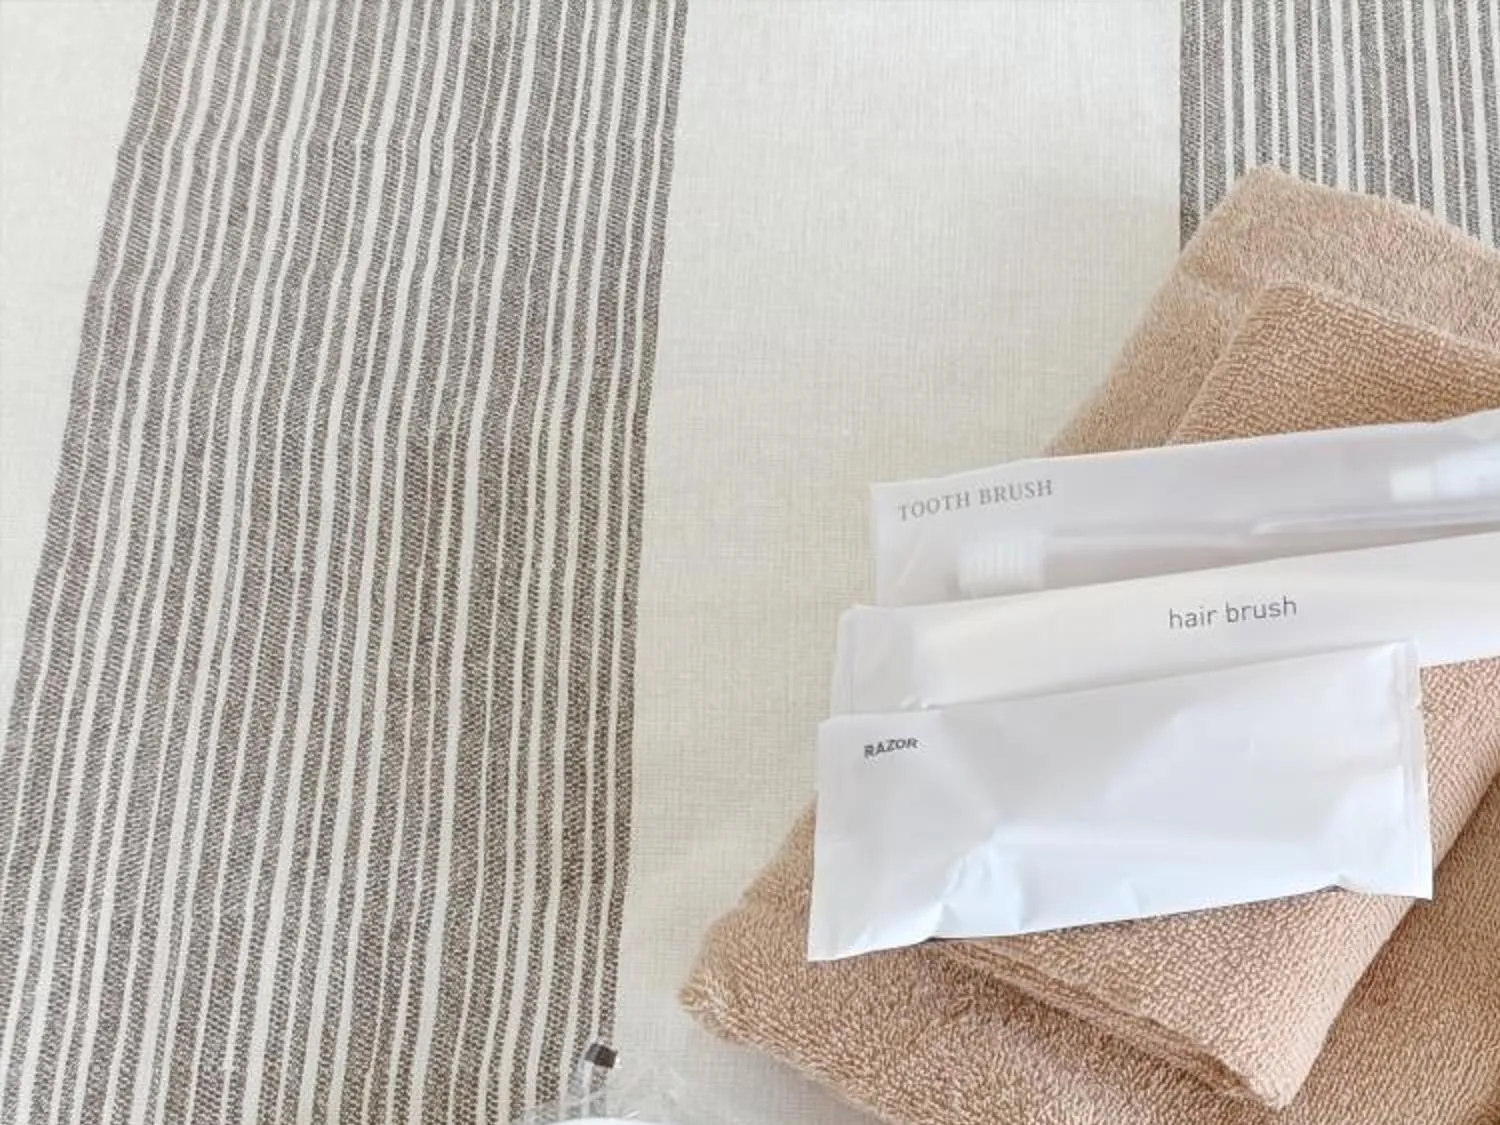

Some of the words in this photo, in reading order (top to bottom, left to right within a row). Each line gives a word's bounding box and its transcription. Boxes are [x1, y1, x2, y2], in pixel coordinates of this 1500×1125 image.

[898, 491, 971, 522] TOOTH
[979, 479, 1054, 506] BRUSH
[1168, 605, 1217, 630] hair
[1226, 595, 1298, 624] brush
[863, 736, 919, 759] RAZOR
